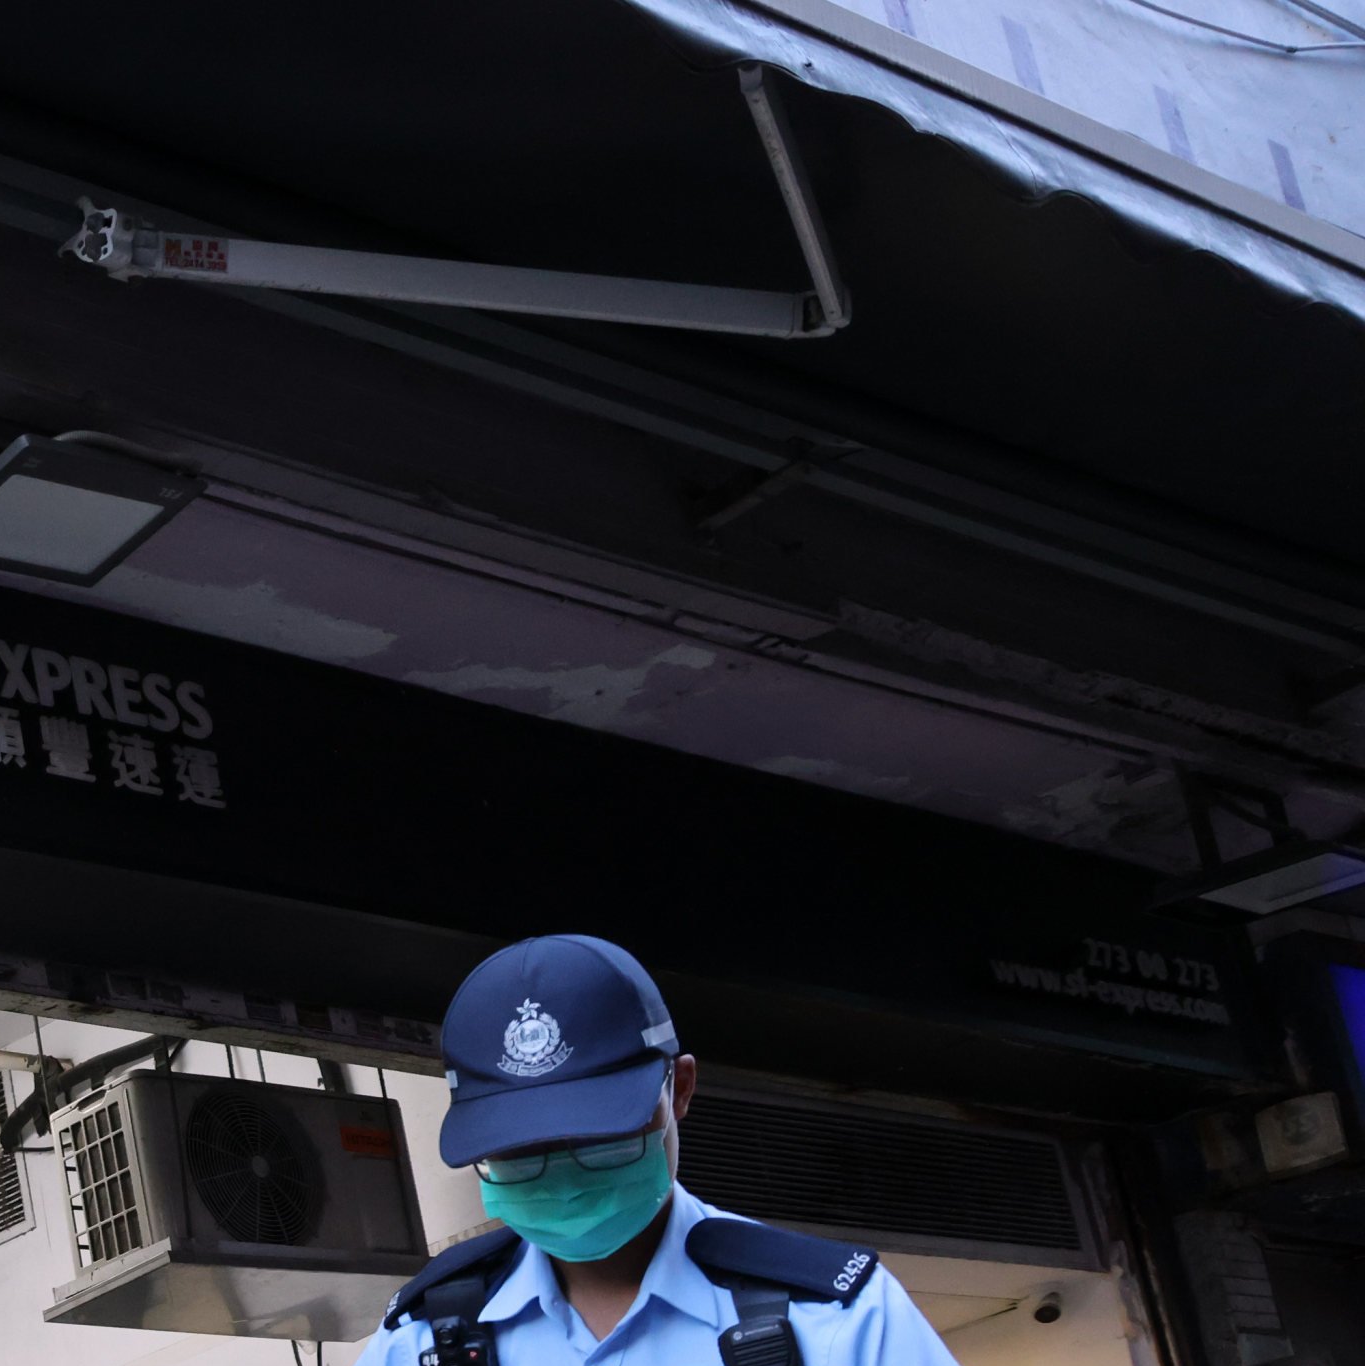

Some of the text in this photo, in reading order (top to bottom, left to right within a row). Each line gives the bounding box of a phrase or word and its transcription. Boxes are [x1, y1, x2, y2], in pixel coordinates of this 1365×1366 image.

[1083, 936, 1131, 975] 273
[1174, 957, 1220, 993] 273
[831, 1251, 872, 1294] 62426
